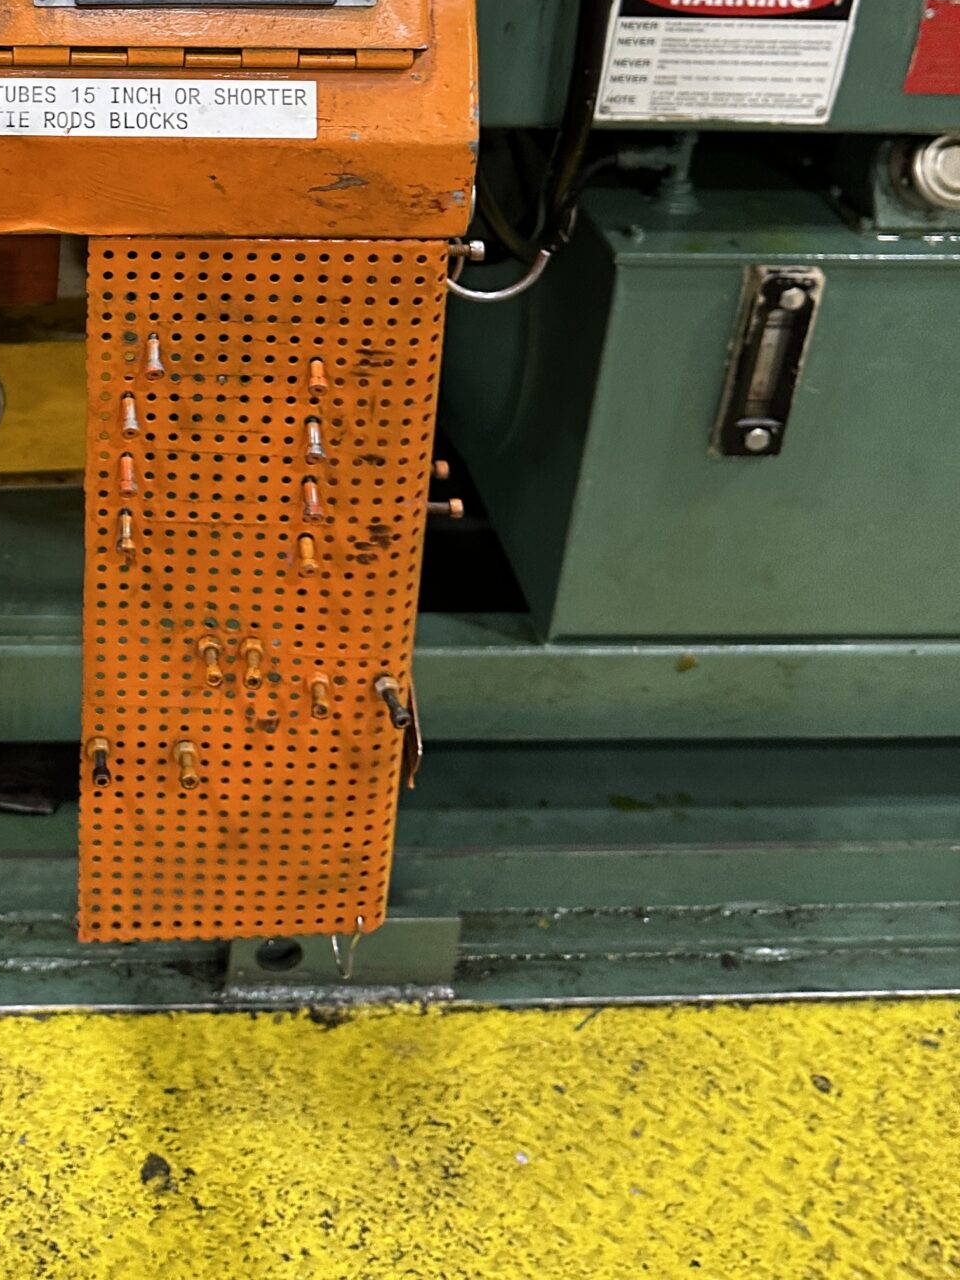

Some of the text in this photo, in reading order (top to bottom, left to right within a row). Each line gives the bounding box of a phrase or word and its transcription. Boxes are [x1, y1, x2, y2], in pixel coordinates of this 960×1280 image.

[71, 86, 95, 103] 15
[111, 87, 161, 104] INCH
[174, 87, 200, 105] OR
[214, 88, 307, 106] SHORTER
[44, 111, 95, 129] RODS
[109, 111, 188, 130] BLOCKS
